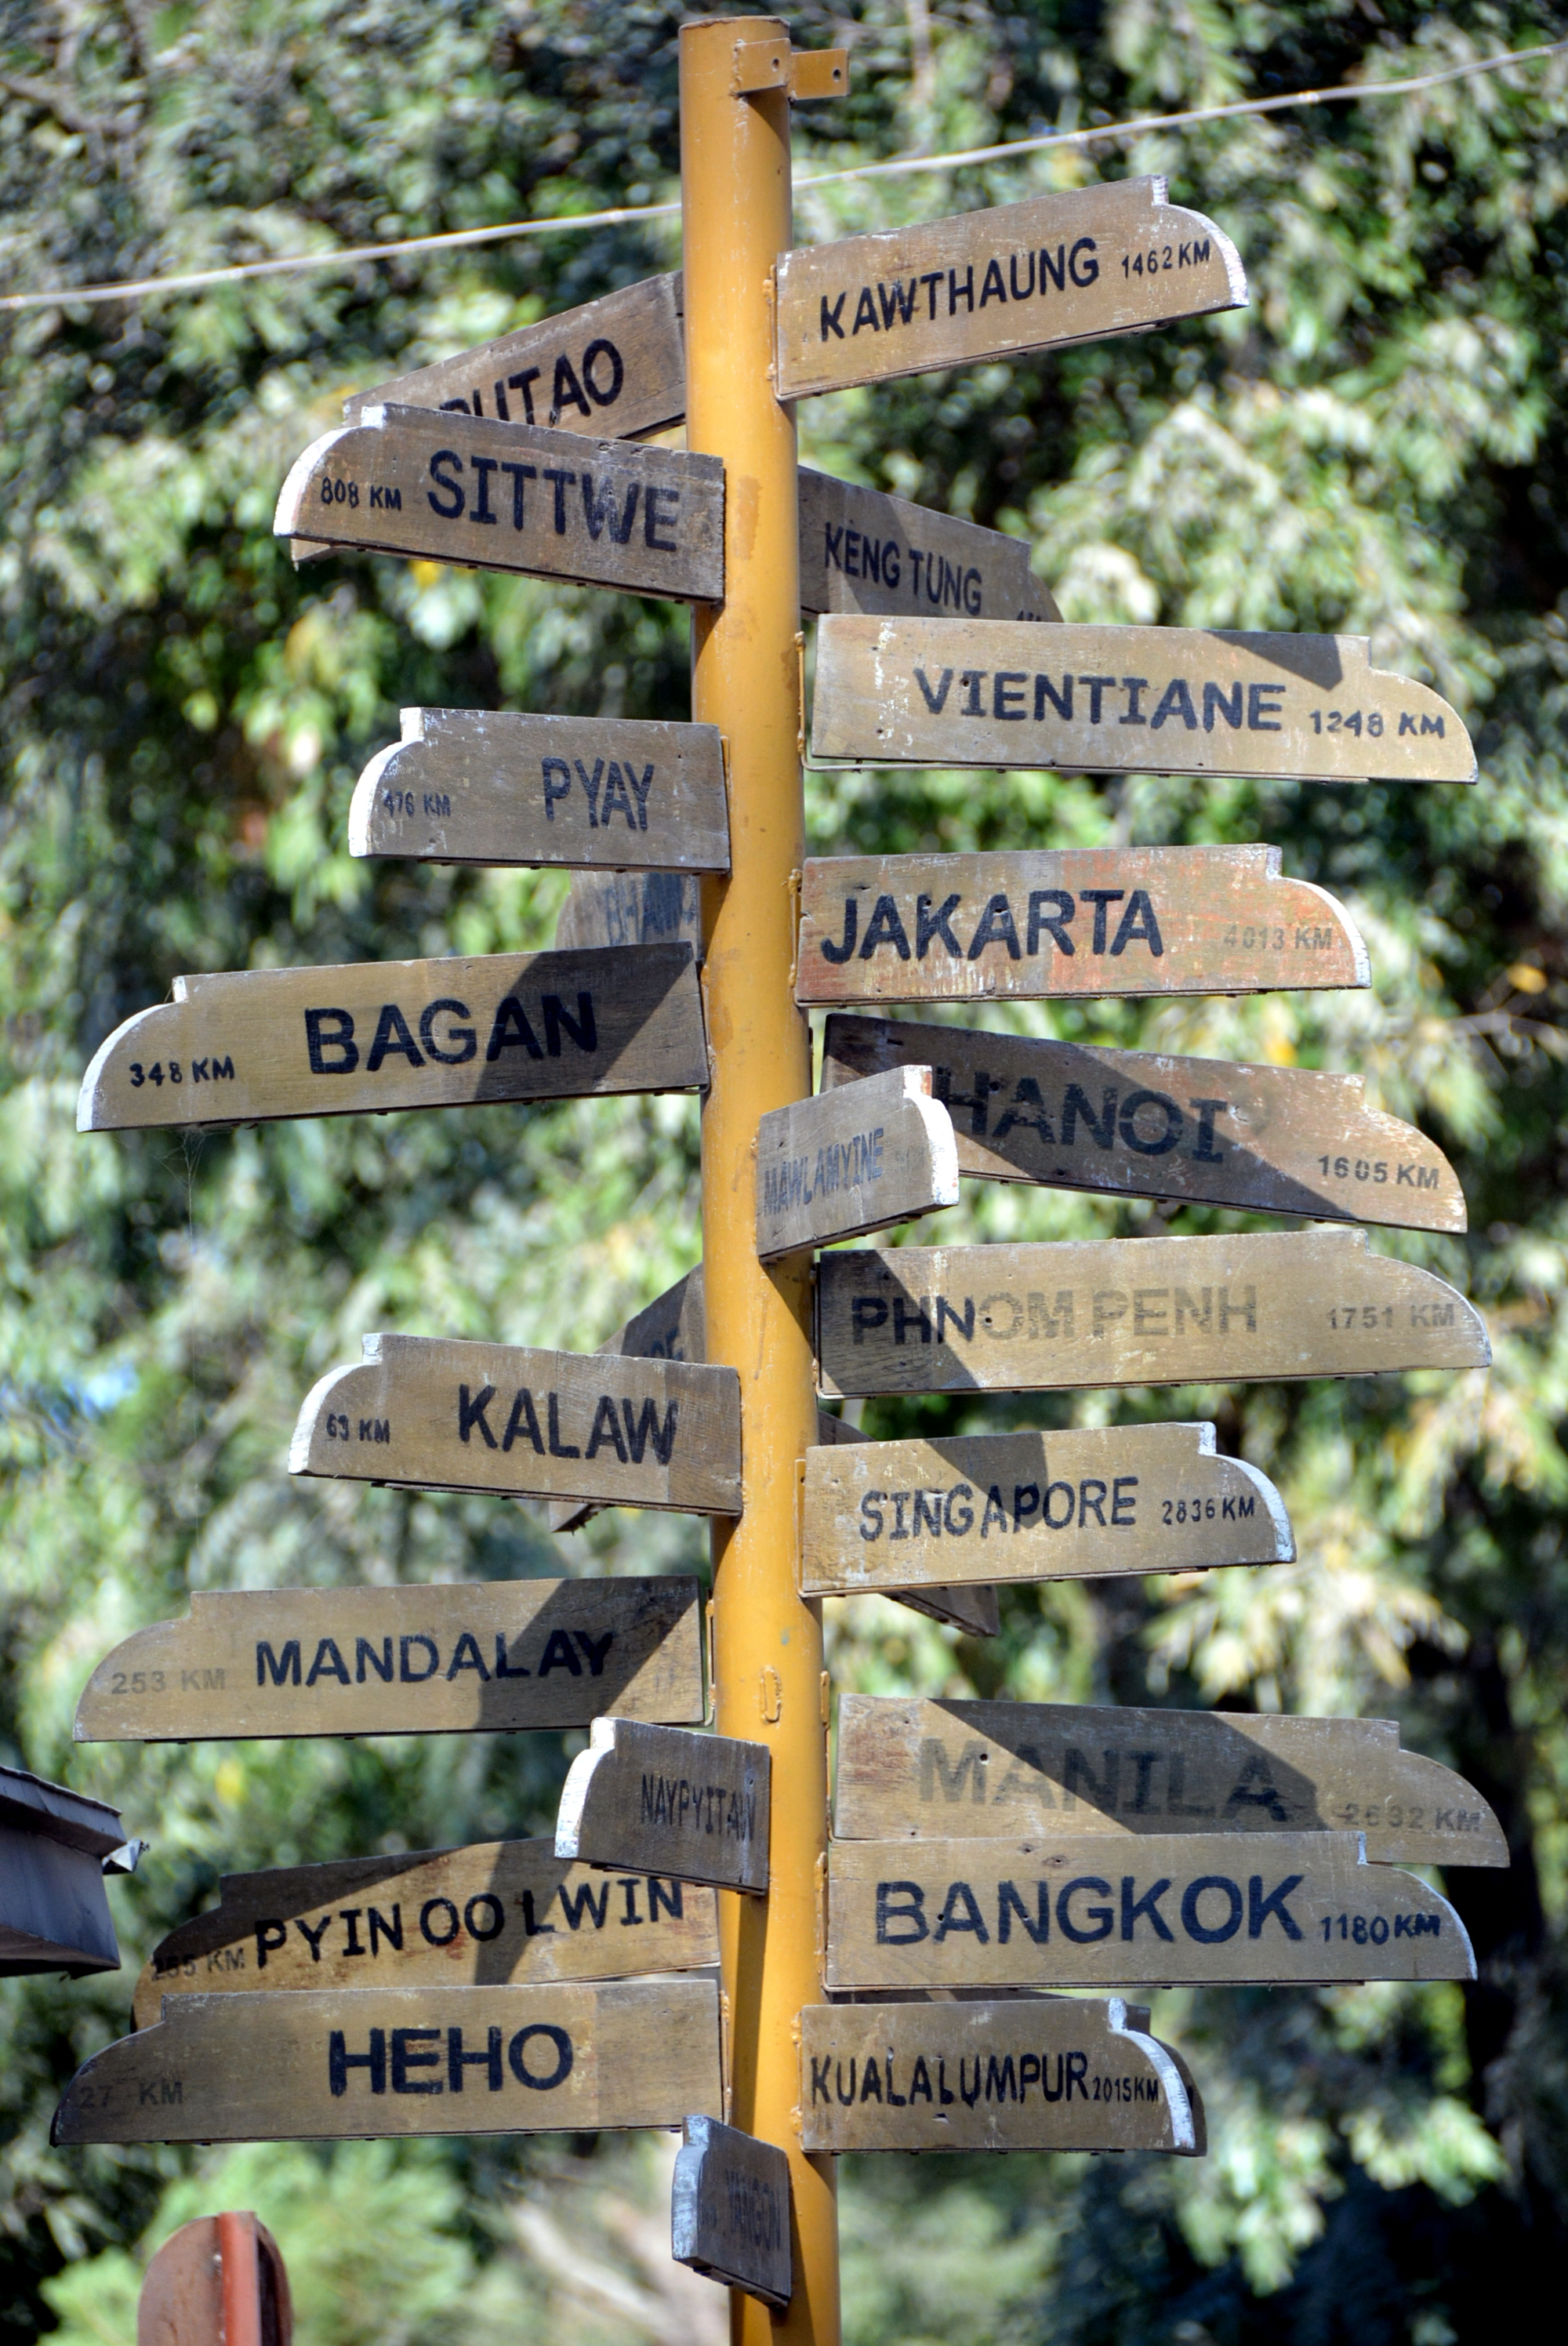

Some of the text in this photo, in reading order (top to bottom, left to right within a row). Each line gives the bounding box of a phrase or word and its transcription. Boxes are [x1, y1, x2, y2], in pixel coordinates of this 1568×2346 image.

[820, 237, 1210, 343] KAWTHAUNG 1462 KM
[439, 338, 624, 429] UTAO
[321, 450, 679, 550] 808 KM SITTWE
[914, 668, 1445, 739] VIENTIANE 1248 KM
[383, 756, 655, 831] 476 KM PYAY
[821, 888, 1333, 965] JAKARTA 4013 KM
[129, 991, 598, 1088] 348 KM BAGAN
[933, 1065, 1229, 1164] HANOI
[1396, 1164, 1440, 1190] KM
[764, 1127, 884, 1215] MAWLAMYINE
[851, 1285, 1455, 1346] PHNOM PENH 1751 KM
[326, 1383, 679, 1465] 63 KM KALAW
[860, 1476, 1254, 1542] SINGAPORE 2836 KM
[111, 1629, 614, 1694] 253 KM MANDALAY
[641, 1774, 757, 1842] NAYPYITAW
[918, 1737, 1290, 1822] MANILA
[1436, 1807, 1482, 1832] KM
[876, 1875, 1305, 1945] BANGKOK
[207, 1947, 246, 1974] KM
[78, 2023, 575, 2109] 27 KM HEHO
[811, 2047, 1088, 2109] KUALALUMPUR
